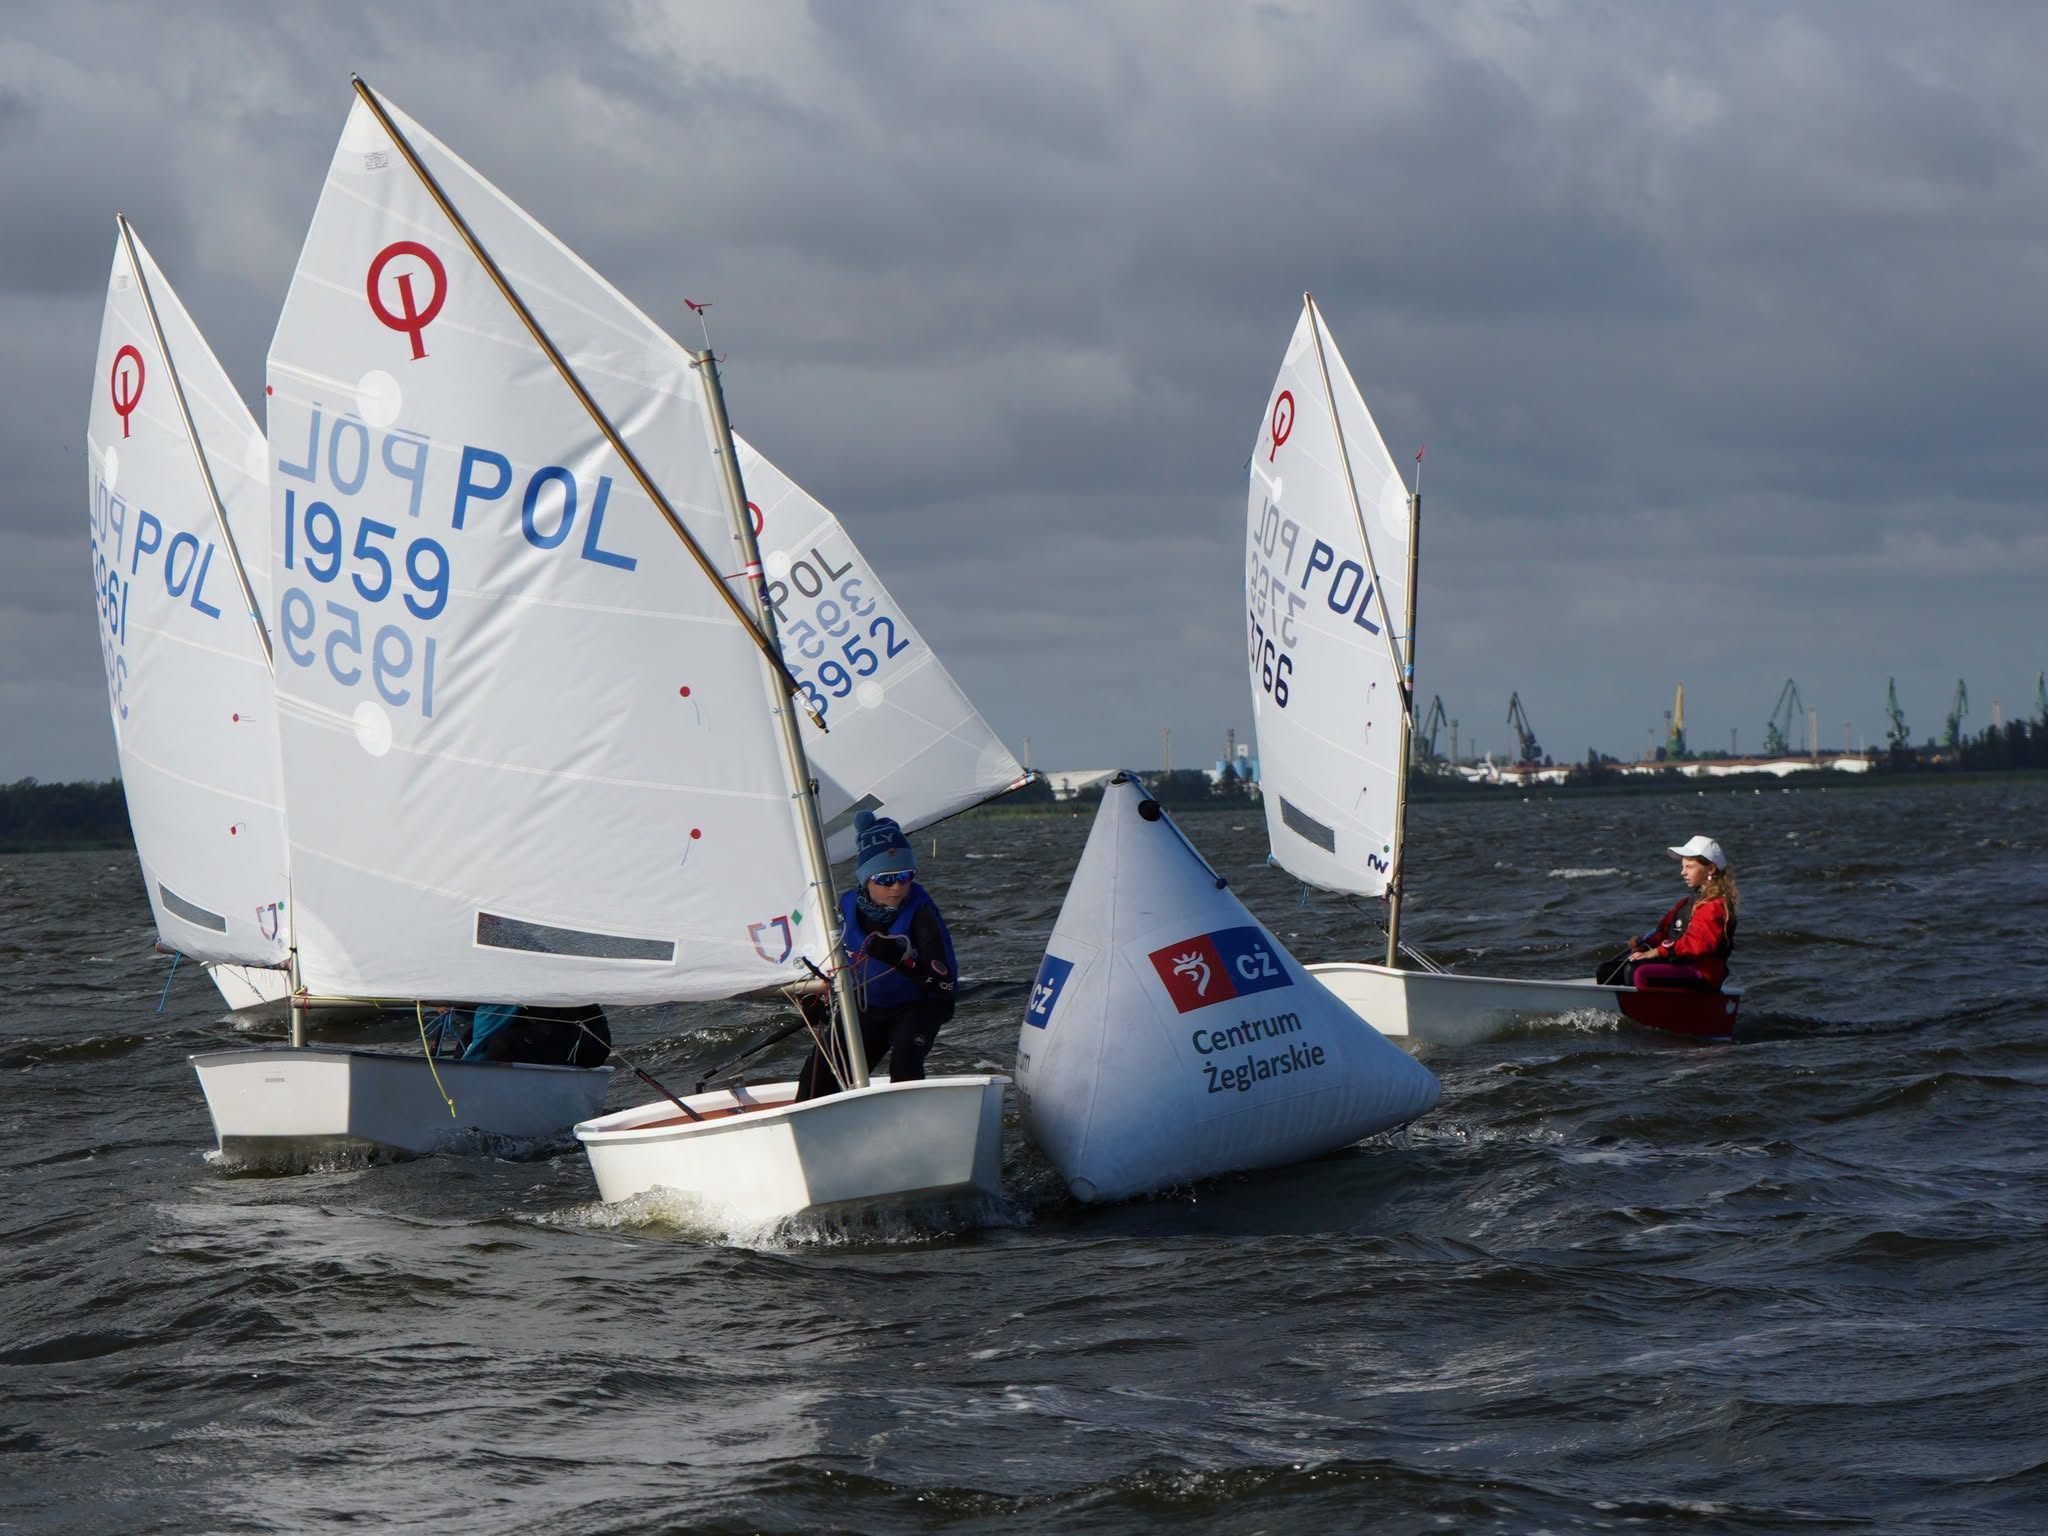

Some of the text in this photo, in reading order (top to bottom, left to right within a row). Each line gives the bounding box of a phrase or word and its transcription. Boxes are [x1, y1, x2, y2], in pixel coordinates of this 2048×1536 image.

[285, 489, 450, 621] 1959
[451, 445, 638, 572] POL
[132, 510, 221, 620] POL
[767, 547, 853, 623] POL
[1301, 538, 1380, 636] POL
[1192, 1012, 1302, 1055] Centrum
[1202, 1042, 1326, 1094] Żeglarskie
